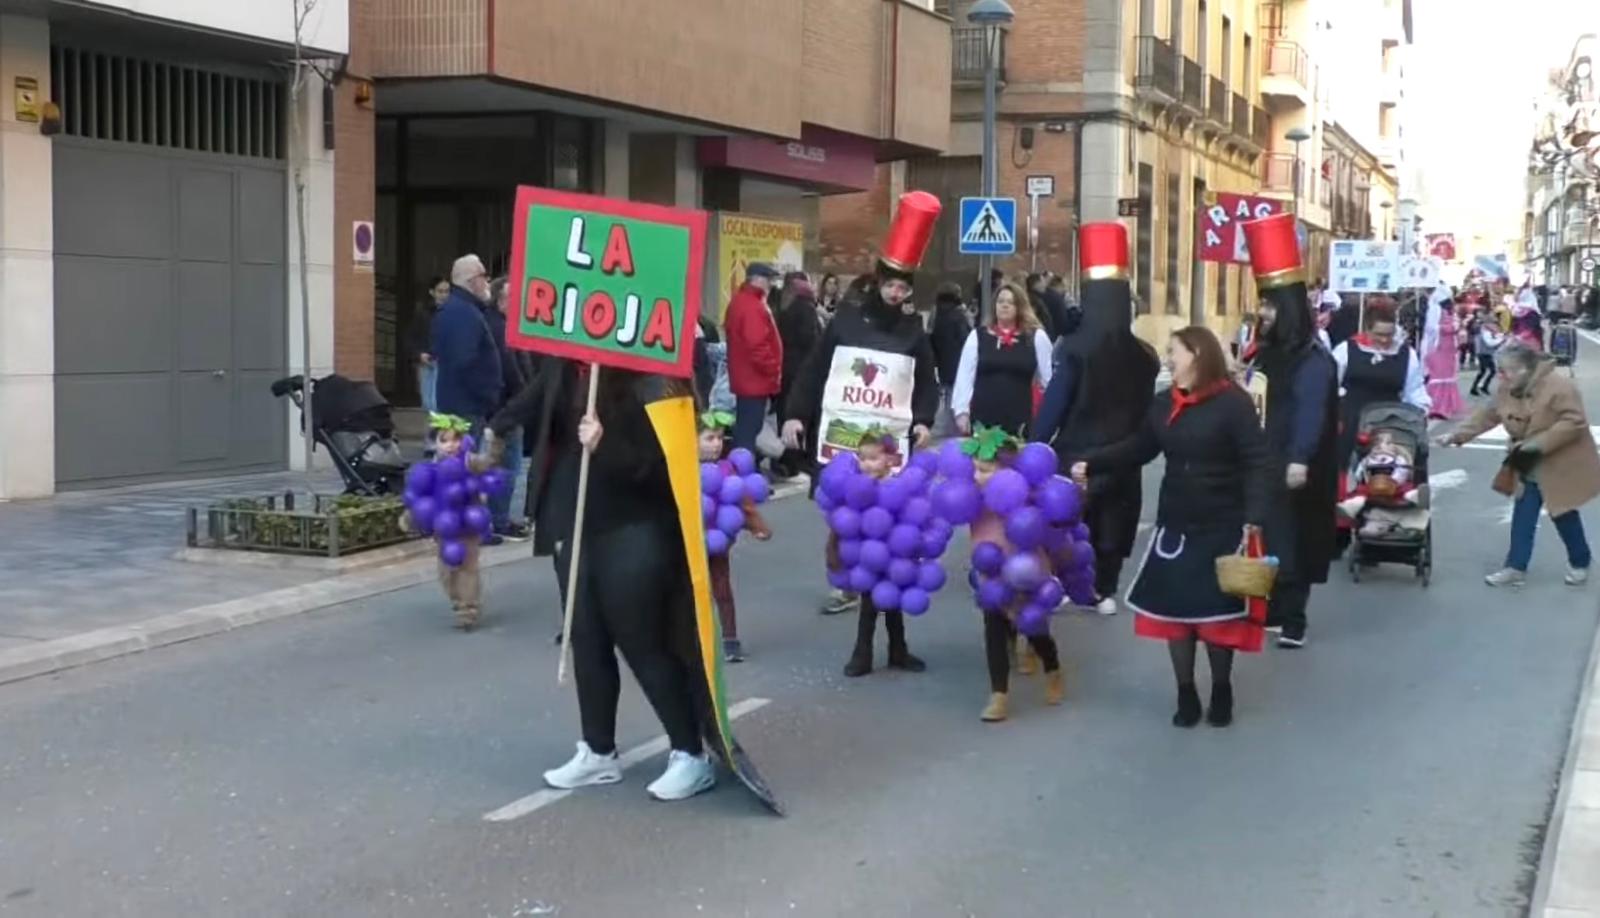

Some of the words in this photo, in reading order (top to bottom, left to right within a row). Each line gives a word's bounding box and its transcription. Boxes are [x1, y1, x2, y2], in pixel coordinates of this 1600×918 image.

[566, 216, 635, 277] LA
[722, 218, 750, 237] LOCAL
[525, 277, 675, 352] RIOJA
[842, 386, 894, 409] RIOJA
